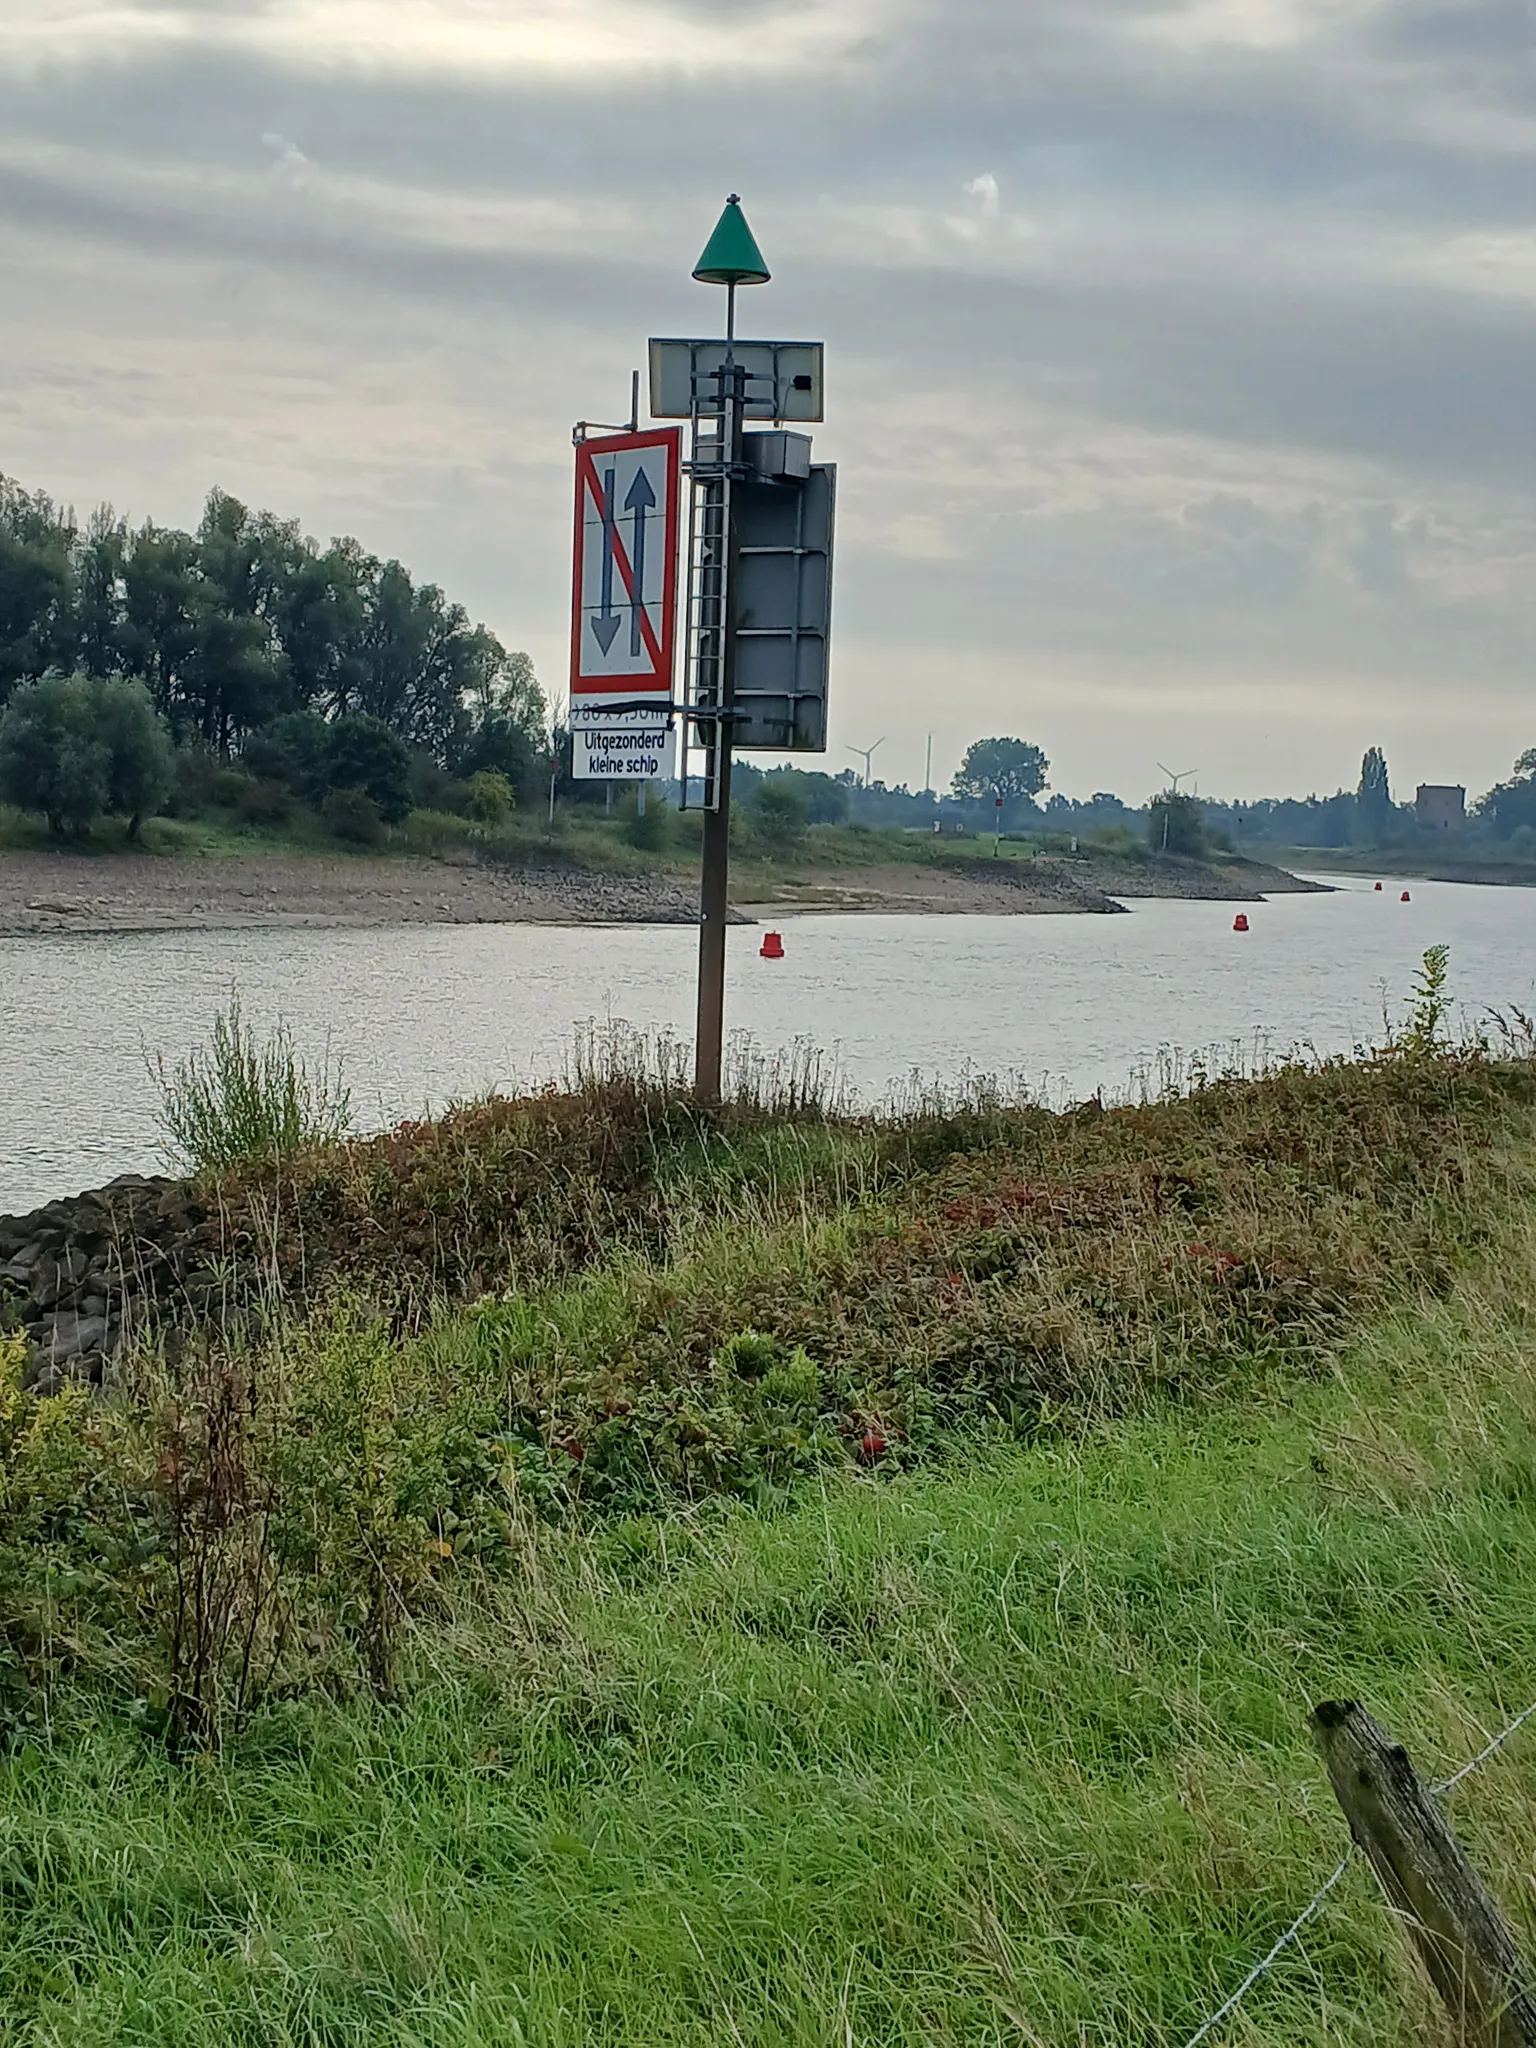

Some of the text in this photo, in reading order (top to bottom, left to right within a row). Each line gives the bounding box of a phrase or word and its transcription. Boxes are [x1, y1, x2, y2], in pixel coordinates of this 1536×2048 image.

[585, 731, 665, 755] Uitgezonderd
[589, 755, 658, 776] kleine schip
